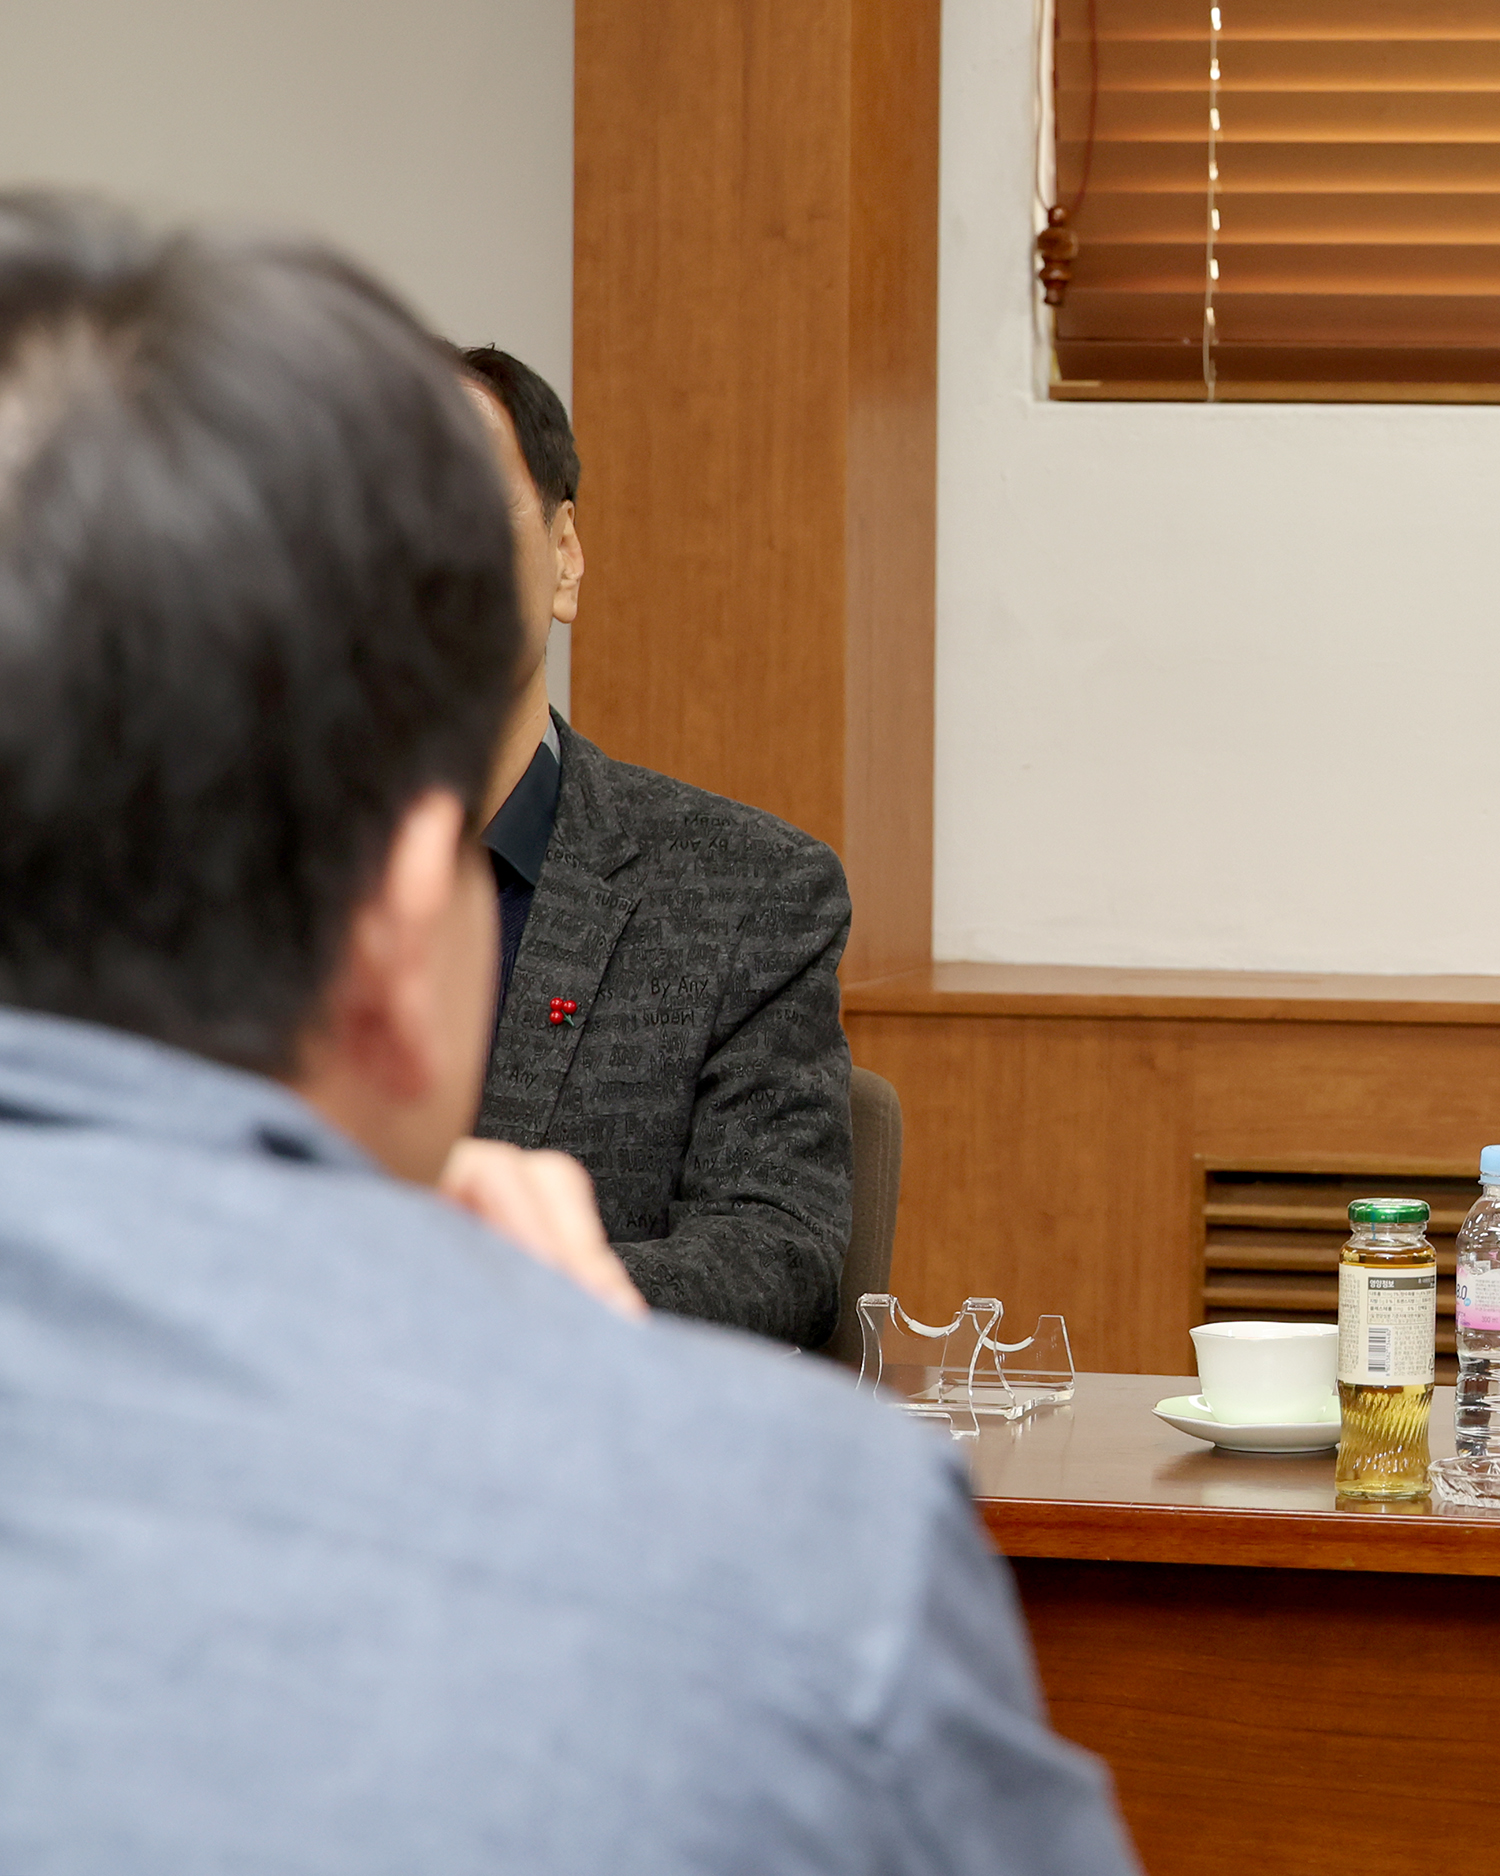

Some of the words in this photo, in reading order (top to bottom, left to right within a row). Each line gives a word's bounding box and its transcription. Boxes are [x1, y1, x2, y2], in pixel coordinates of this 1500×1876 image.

[651, 977, 671, 1002] By
[678, 976, 709, 996] Any
[1369, 1279, 1395, 1289] 영양정보
